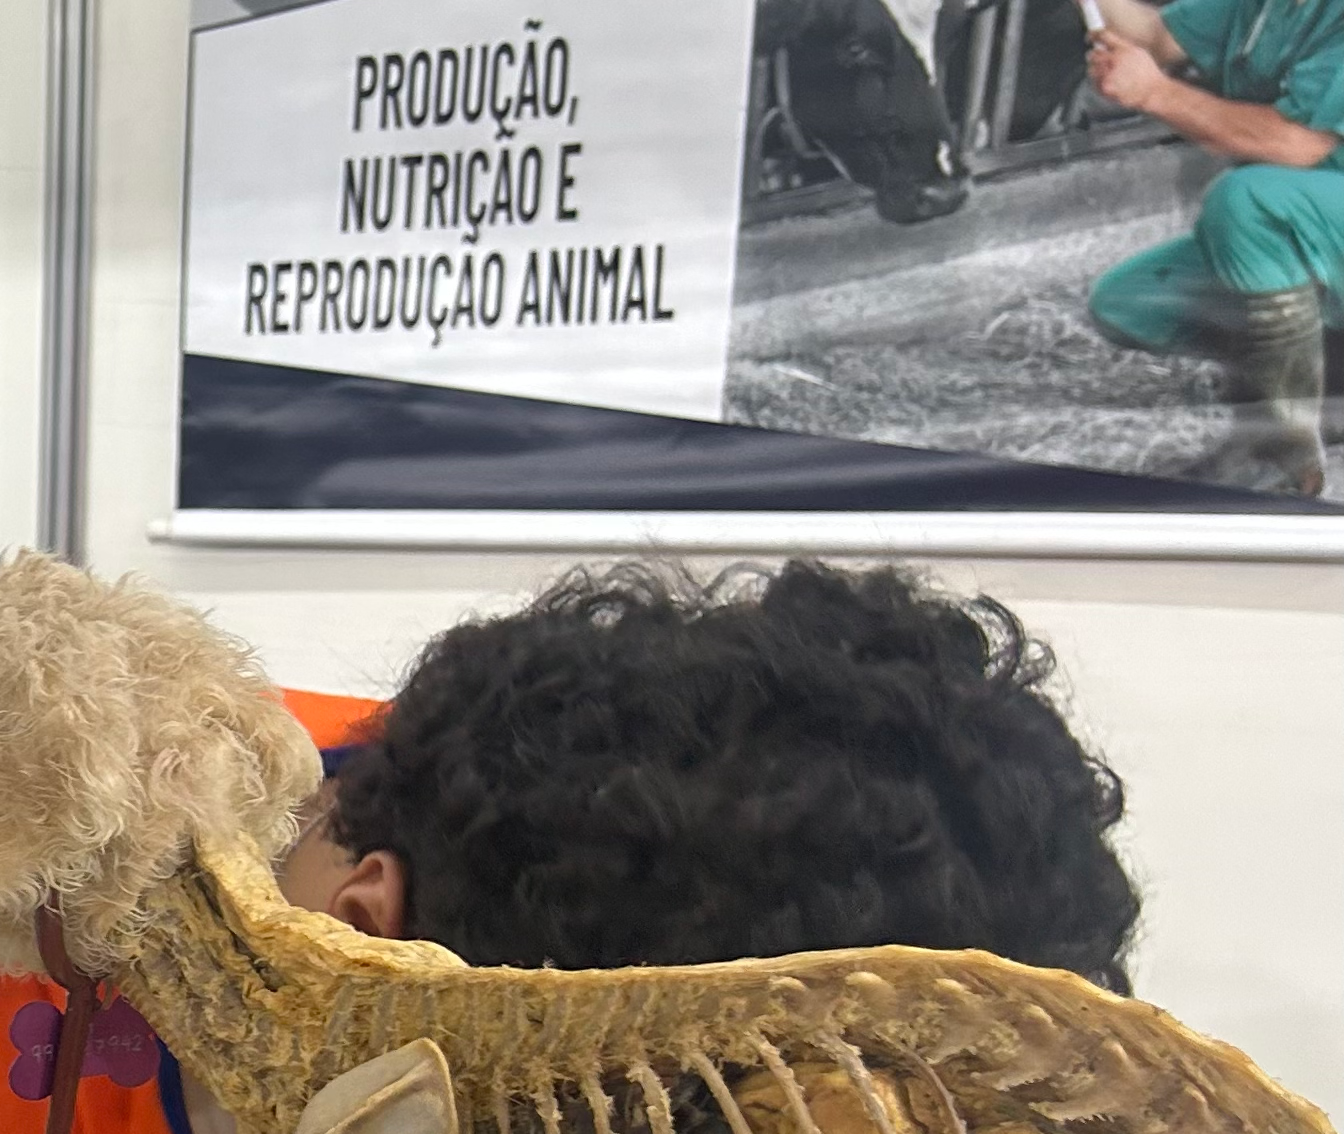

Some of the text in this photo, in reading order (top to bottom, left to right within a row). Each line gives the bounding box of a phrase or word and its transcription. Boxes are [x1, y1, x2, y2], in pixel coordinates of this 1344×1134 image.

[352, 18, 579, 132] PRODUÇÃO,
[339, 129, 583, 234] NUTRIÇÃO E
[243, 232, 675, 348] REPRODUÇÃO ANIMAL
